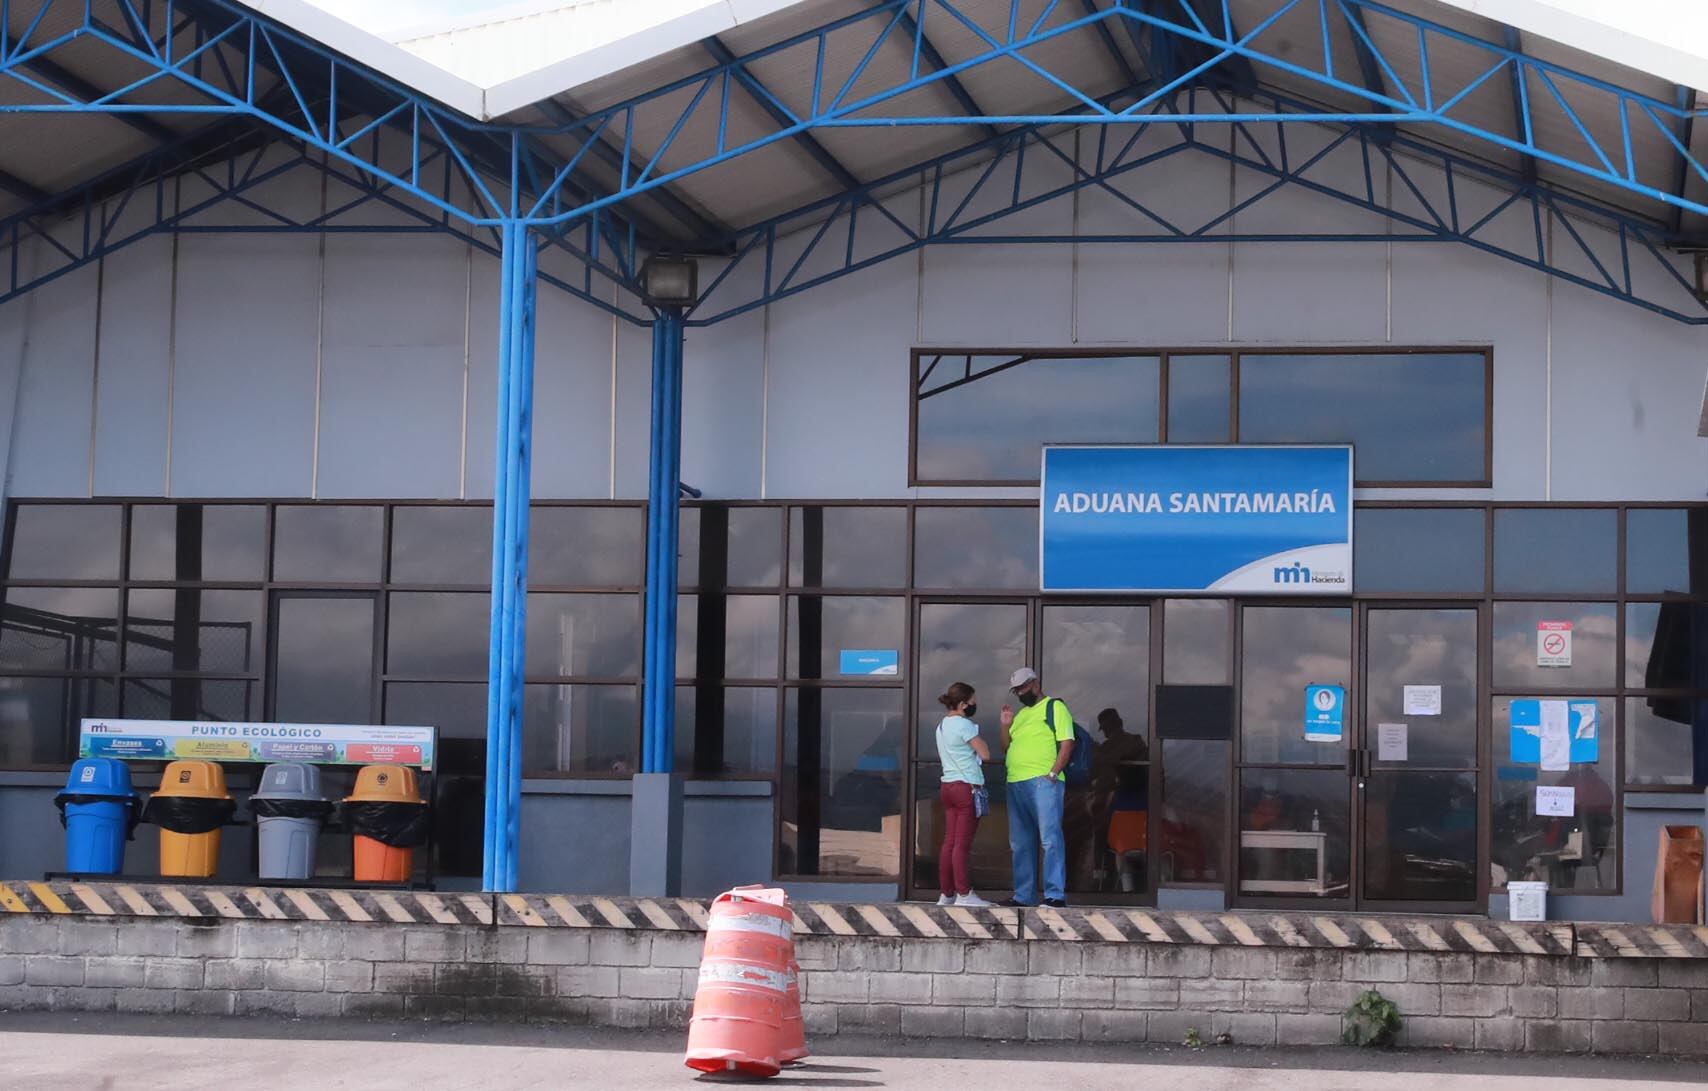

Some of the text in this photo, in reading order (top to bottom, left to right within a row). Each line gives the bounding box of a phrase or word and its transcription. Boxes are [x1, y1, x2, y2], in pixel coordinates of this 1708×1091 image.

[1054, 488, 1336, 513] ADUANA SANTAMARÍA
[1312, 575, 1346, 584] Hacienda
[191, 725, 322, 738] PUNTO ECOLÓGICO
